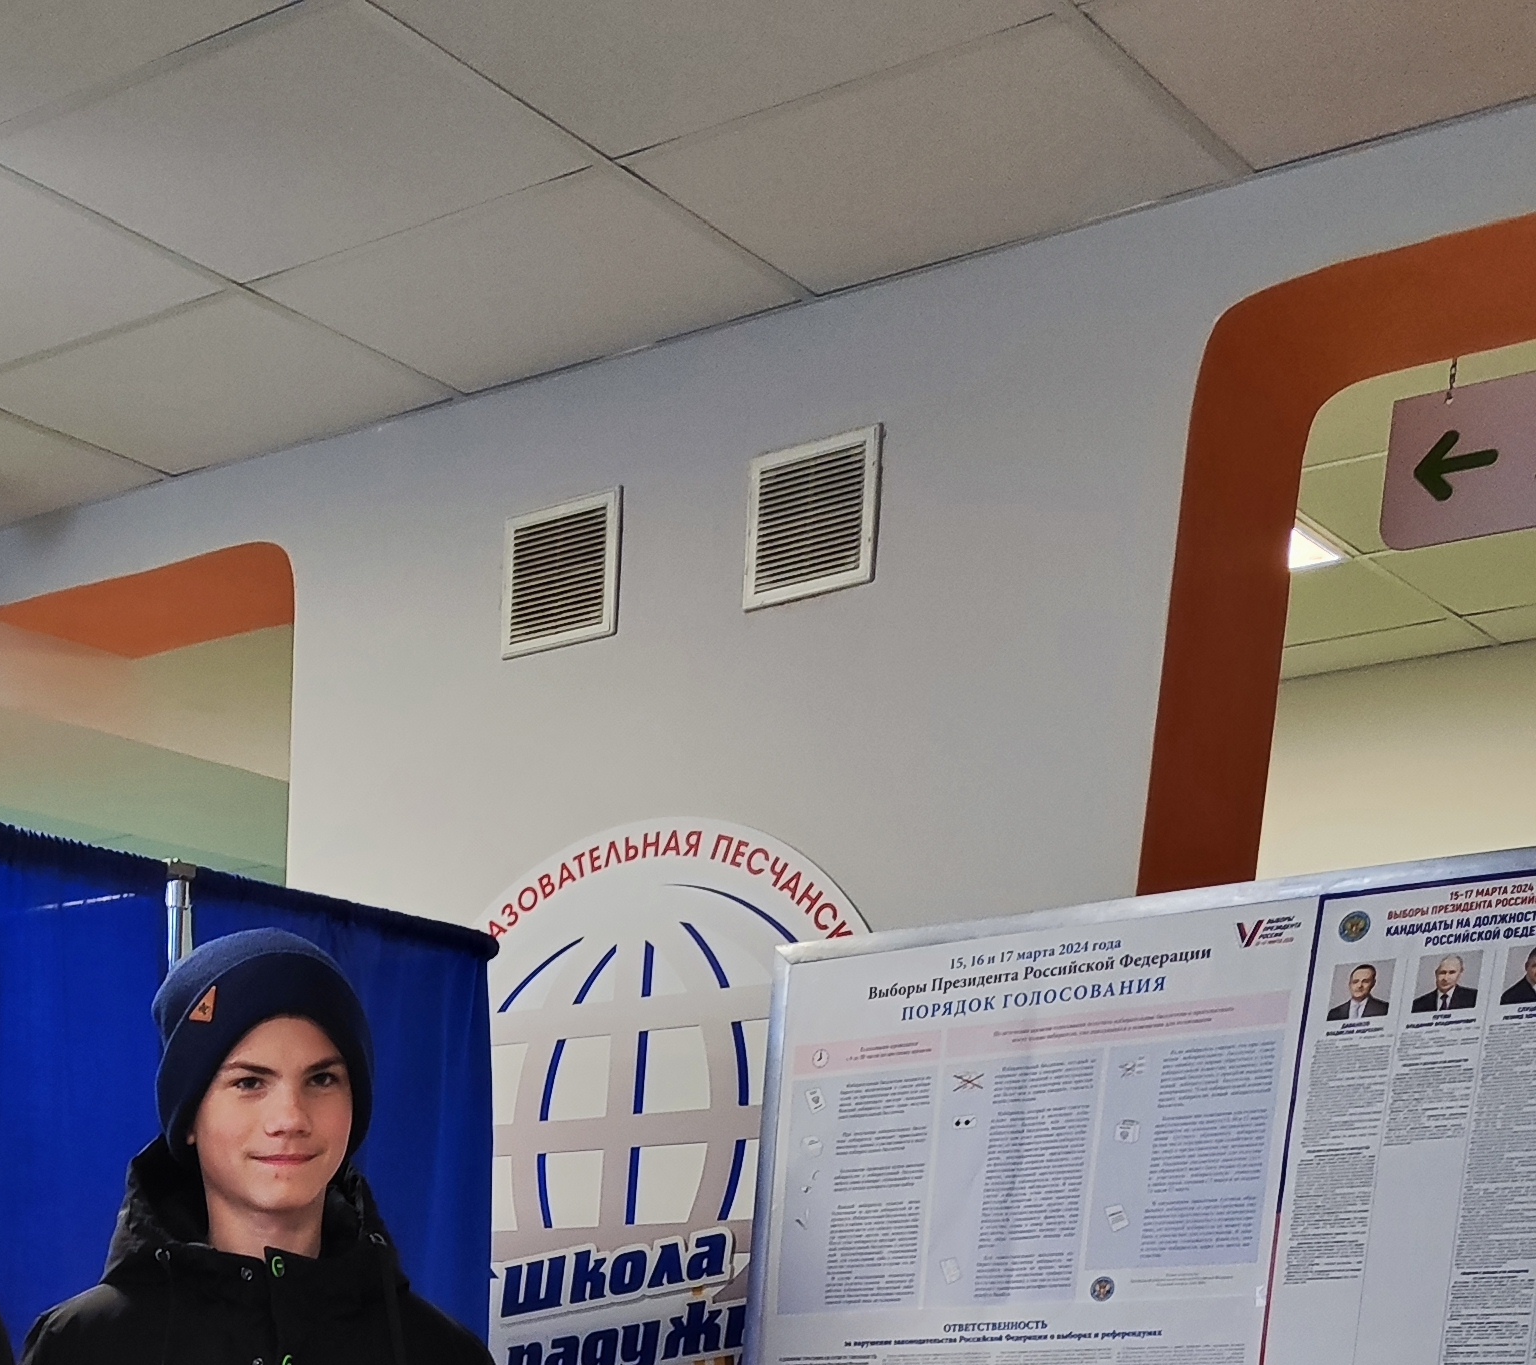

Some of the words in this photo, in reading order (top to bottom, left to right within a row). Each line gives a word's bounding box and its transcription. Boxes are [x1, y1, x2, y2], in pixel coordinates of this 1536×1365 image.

[1475, 886, 1508, 898] МАРТА
[1511, 883, 1534, 894] 2024
[1387, 906, 1429, 920] ВЫБОРЫ
[1431, 900, 1493, 916] ПРЕЗИДЕНТА
[1495, 893, 1536, 908] РОССИЙ
[1386, 919, 1454, 937] КАНДИДАТЫ
[1456, 917, 1471, 929] НА
[1425, 927, 1501, 947] РОССИЙСКОЙ
[950, 957, 967, 970] 15,
[971, 955, 984, 967] 16
[987, 956, 995, 964] и
[1000, 951, 1014, 963] 17
[1016, 947, 1055, 962] марта
[1058, 941, 1089, 956] 2024
[1092, 939, 1122, 952] года
[868, 982, 927, 1000] Выборы
[931, 970, 1019, 994] Президента
[1023, 956, 1115, 980] Российской
[1119, 948, 1212, 969] Федерации
[901, 995, 996, 1021] ПОРЯДОК
[1002, 976, 1167, 1009] ГОЛОСОВАНИЯ
[500, 1233, 727, 1318] Школа
[943, 1320, 1048, 1333] ОТВЕТСТВЕННОСТЬ
